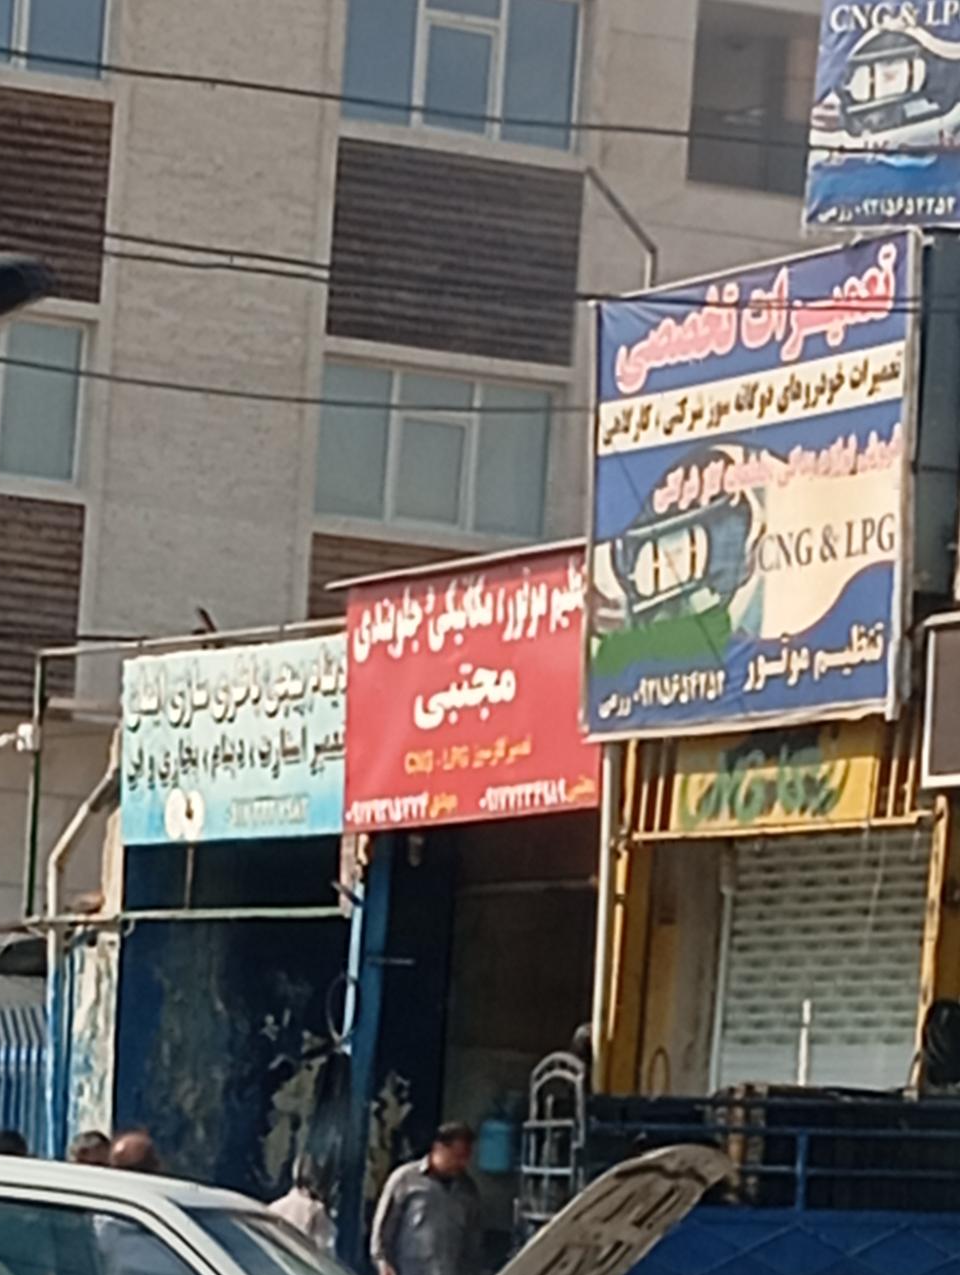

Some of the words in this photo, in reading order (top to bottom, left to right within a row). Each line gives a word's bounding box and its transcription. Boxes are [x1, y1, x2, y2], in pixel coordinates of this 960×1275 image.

[830, 1, 886, 33] CNG
[926, 1, 960, 26] LP
[741, 243, 898, 361] تعمیرات
[615, 282, 740, 395] تخصصی
[777, 362, 845, 414] خودروهای
[850, 350, 904, 397] تعمیرات
[758, 528, 812, 572] CNG
[820, 524, 839, 563] &
[845, 513, 895, 558] LPG
[353, 586, 423, 663] جلوبندی
[813, 622, 885, 681] تنظیم
[743, 633, 809, 692] موتور
[414, 663, 517, 729] مجتبی
